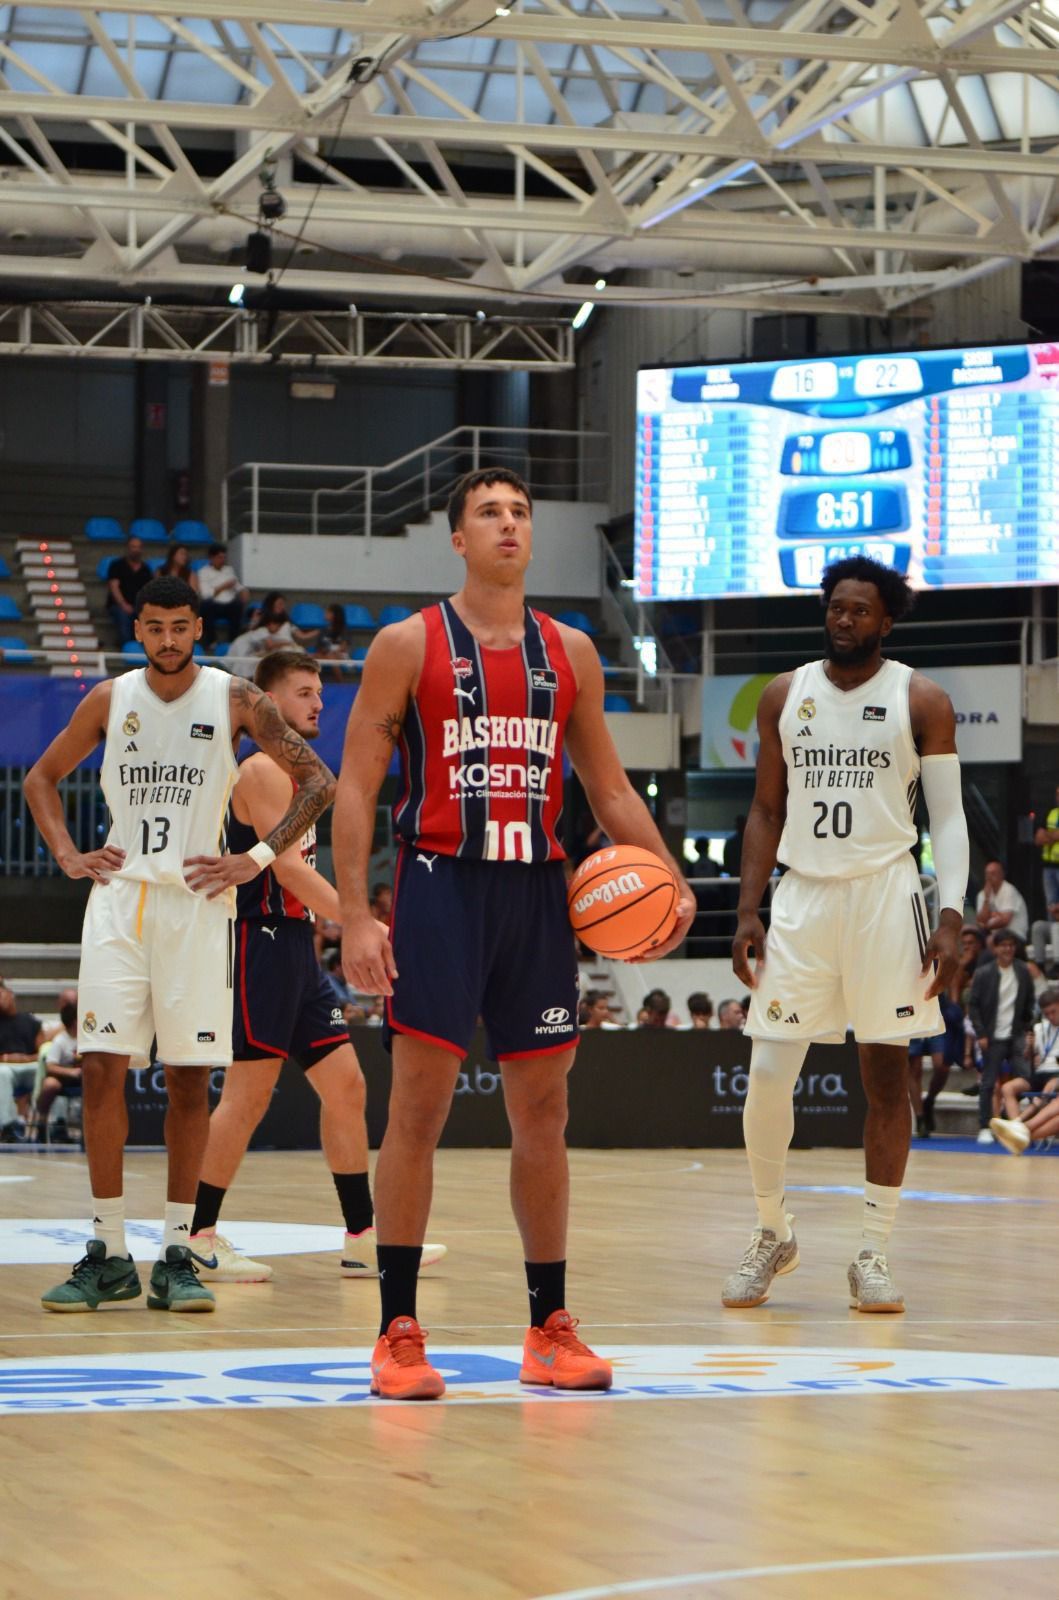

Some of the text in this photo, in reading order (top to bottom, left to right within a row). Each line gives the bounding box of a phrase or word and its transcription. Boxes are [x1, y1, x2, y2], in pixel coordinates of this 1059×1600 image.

[794, 368, 815, 393] 16
[875, 363, 899, 388] 22
[816, 490, 873, 529] 8:51
[442, 715, 559, 760] BASKONIA
[791, 743, 891, 769] Emirates
[119, 760, 206, 786] Emirates
[804, 770, 874, 789] FLY BETTER
[128, 786, 192, 806] FLY BETTER
[812, 800, 853, 839] 20
[141, 816, 171, 855] 13
[484, 820, 532, 863] 10
[574, 871, 646, 913] Wilson
[535, 1024, 574, 1035] HYUNDAI
